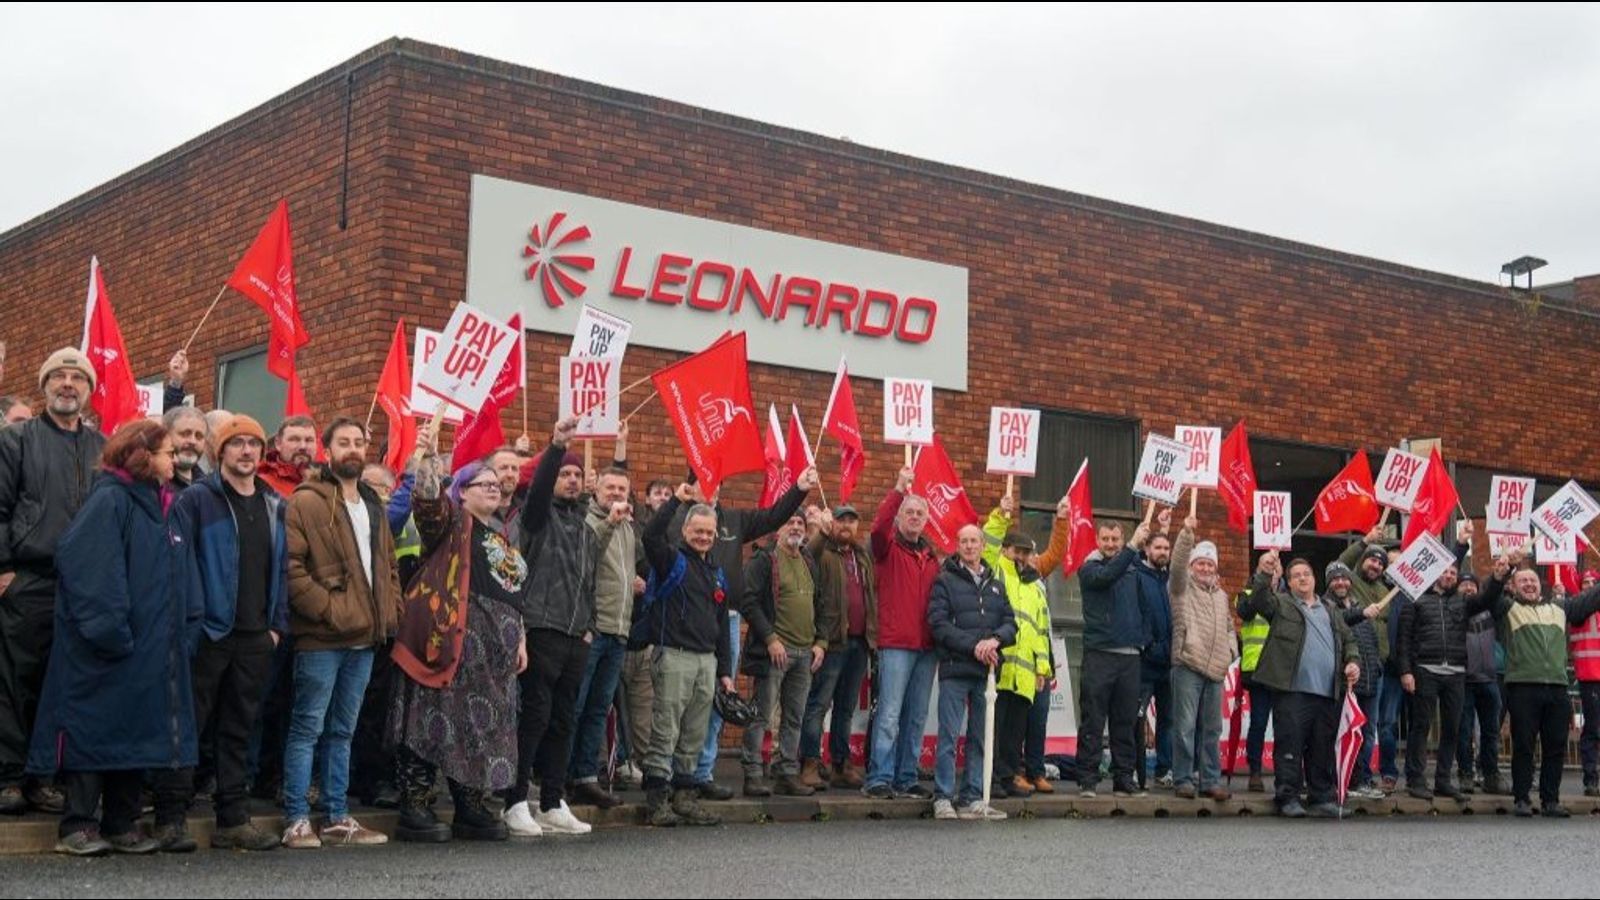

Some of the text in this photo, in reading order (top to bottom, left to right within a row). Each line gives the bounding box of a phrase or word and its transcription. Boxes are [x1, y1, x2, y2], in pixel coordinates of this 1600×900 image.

[608, 247, 938, 344] LEONARDO
[455, 312, 506, 357] PAY
[590, 323, 616, 346] PAY
[589, 340, 608, 357] UP
[443, 344, 488, 387] UP!
[570, 361, 611, 389] PAY
[572, 390, 606, 417] UP!
[892, 382, 925, 405] PAY
[894, 405, 922, 428] UP!
[999, 411, 1033, 436] PAY
[999, 435, 1028, 458] UP!
[1182, 429, 1215, 451] PAY
[1154, 449, 1178, 466] PAY
[1389, 453, 1423, 478] PAY
[1153, 463, 1172, 477] UP
[1143, 472, 1175, 493] NOW!
[1384, 472, 1412, 497] UP!
[1498, 479, 1528, 501] PAY
[1260, 494, 1287, 515] PAY
[1497, 501, 1524, 521] UP!
[1556, 506, 1573, 521] UP
[1562, 496, 1585, 517] PAY
[1262, 515, 1285, 535] UP!
[1541, 509, 1570, 537] NOW!
[1411, 558, 1428, 573] UP
[1417, 547, 1439, 568] PAY
[1396, 561, 1425, 589] NOW!
